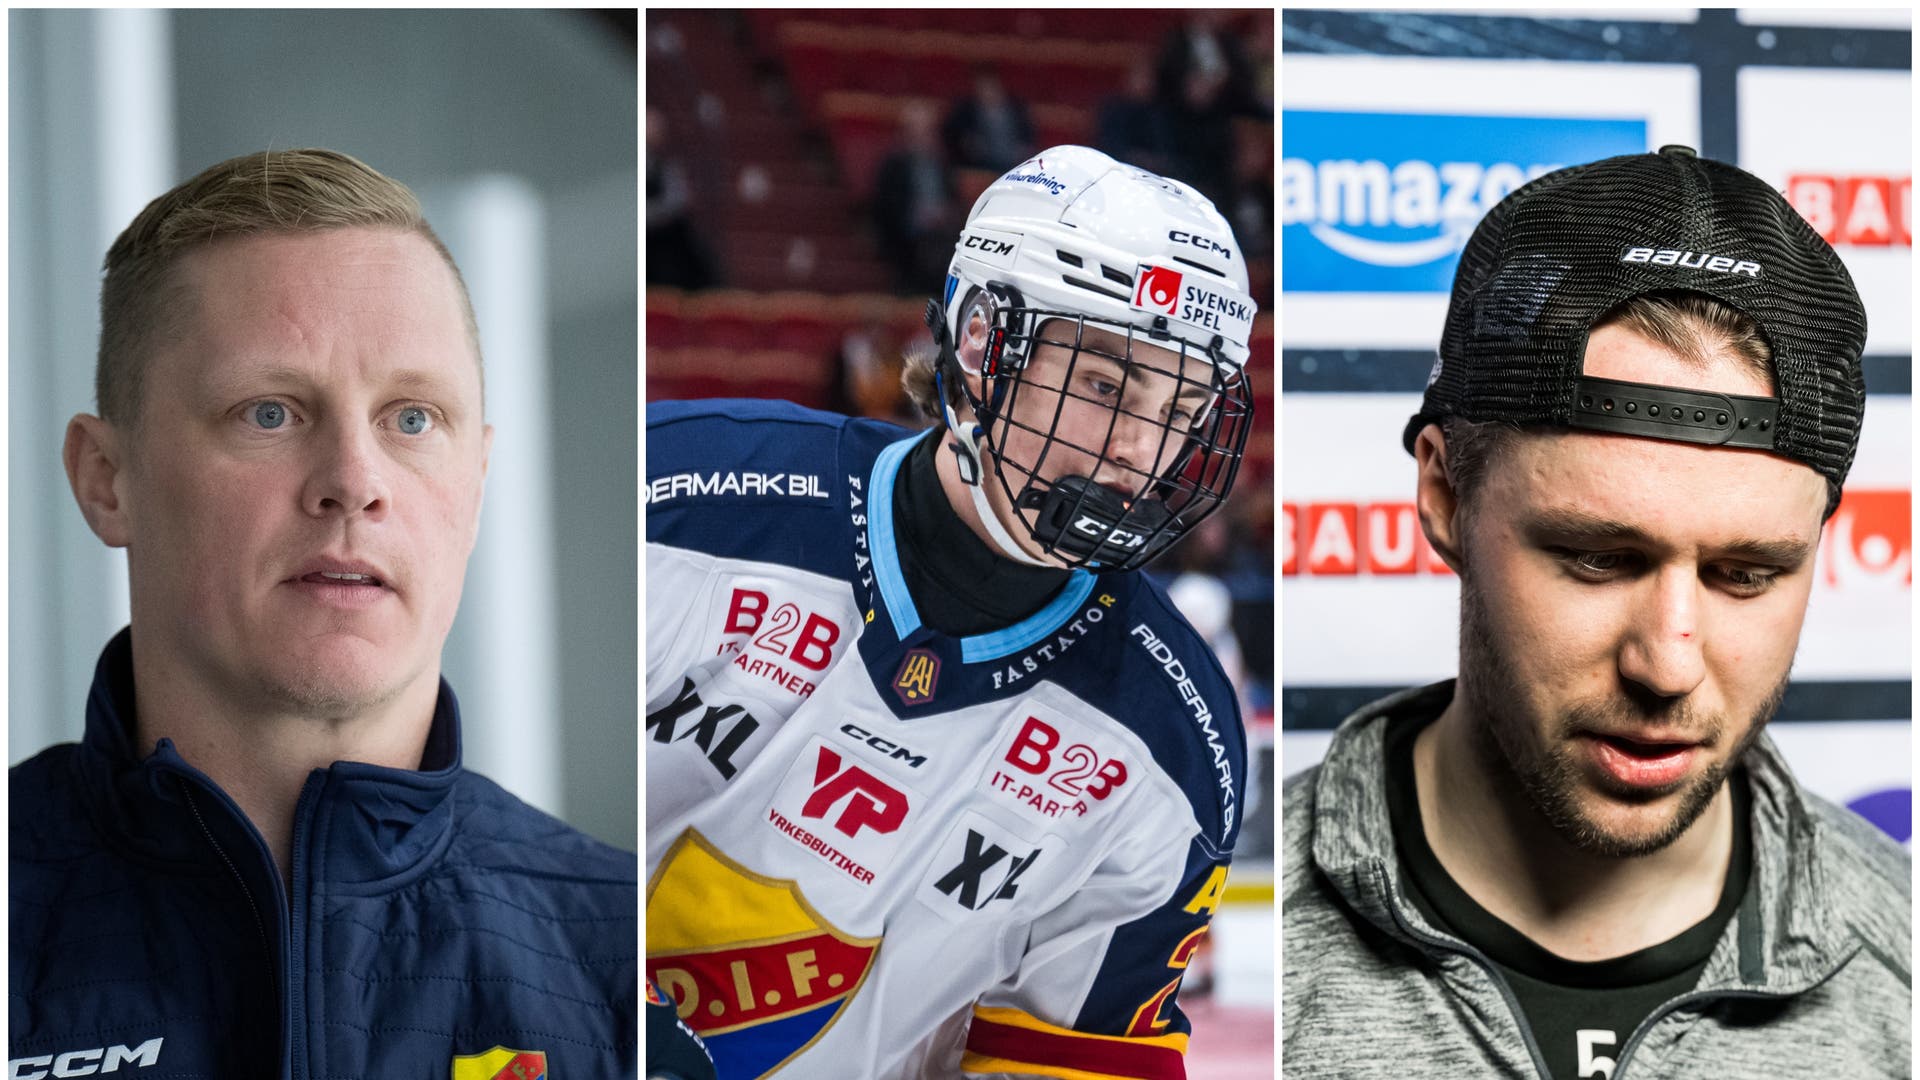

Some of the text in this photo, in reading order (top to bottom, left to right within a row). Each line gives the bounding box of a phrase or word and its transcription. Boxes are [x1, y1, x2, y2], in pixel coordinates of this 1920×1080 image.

[1282, 157, 1563, 227] amazo
[965, 235, 1015, 256] CCM
[1168, 229, 1231, 259] CCM
[1182, 304, 1221, 332] SPEL
[788, 474, 829, 498] BIL
[723, 588, 840, 672] B2B
[992, 593, 1116, 689] FASTATOR
[717, 641, 816, 699] IT-ARTNER
[646, 676, 760, 782] XXL
[1131, 623, 1235, 806] RIDDERMARK
[840, 723, 928, 769] CCM
[768, 808, 876, 886] YRKESBUTIKER
[1183, 865, 1232, 914] A
[656, 948, 844, 1019] D.I.F.
[8, 1037, 164, 1080] CCM
